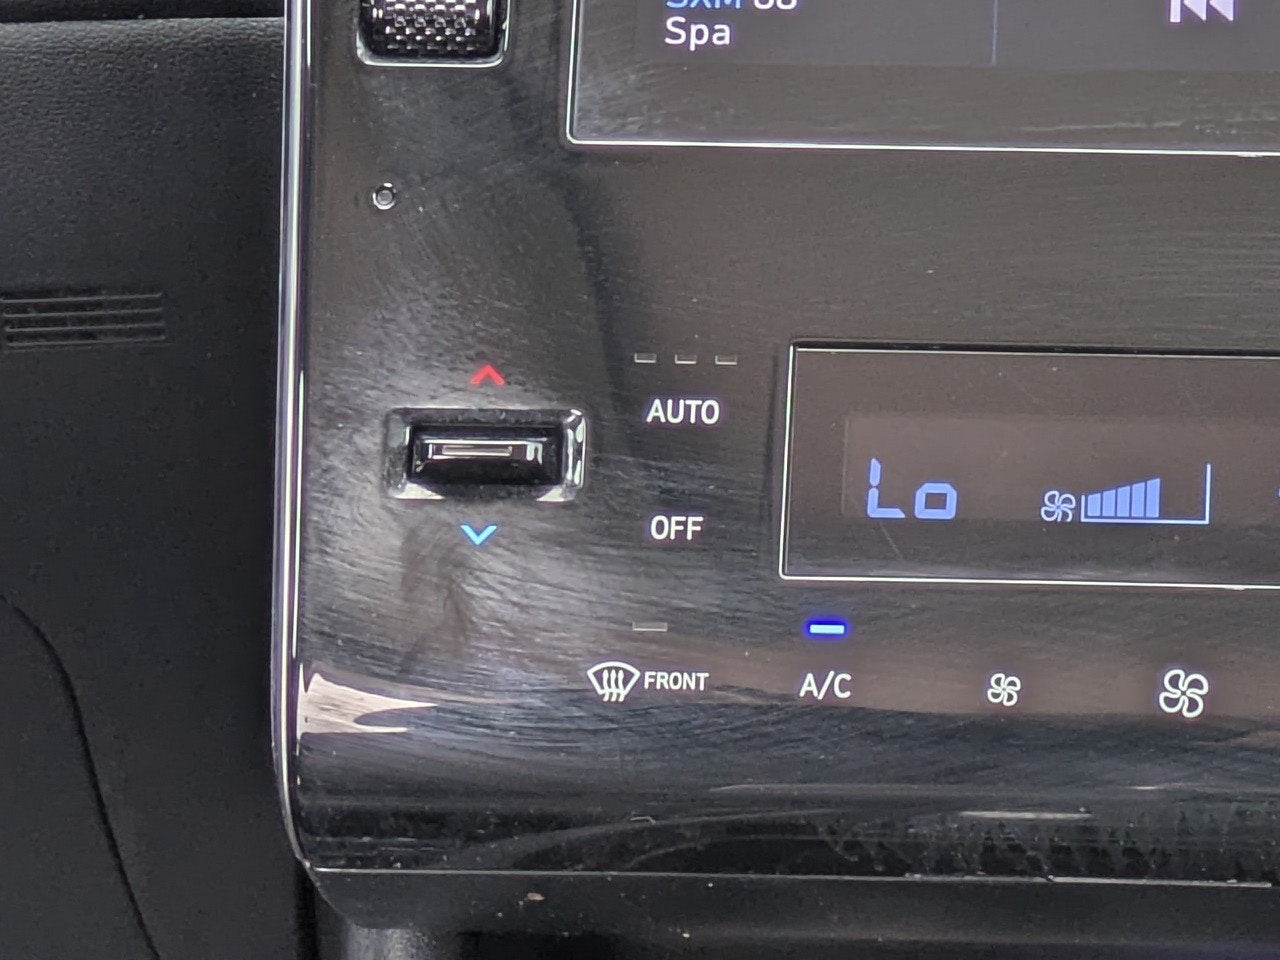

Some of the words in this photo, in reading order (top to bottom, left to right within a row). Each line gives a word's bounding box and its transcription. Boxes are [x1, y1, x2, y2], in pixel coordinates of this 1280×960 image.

[664, 15, 731, 52] Spa
[646, 398, 720, 425] AUTO
[866, 458, 958, 520] Lo
[650, 515, 704, 541] OFF
[643, 671, 710, 691] FRONT
[799, 670, 852, 700] A/C
